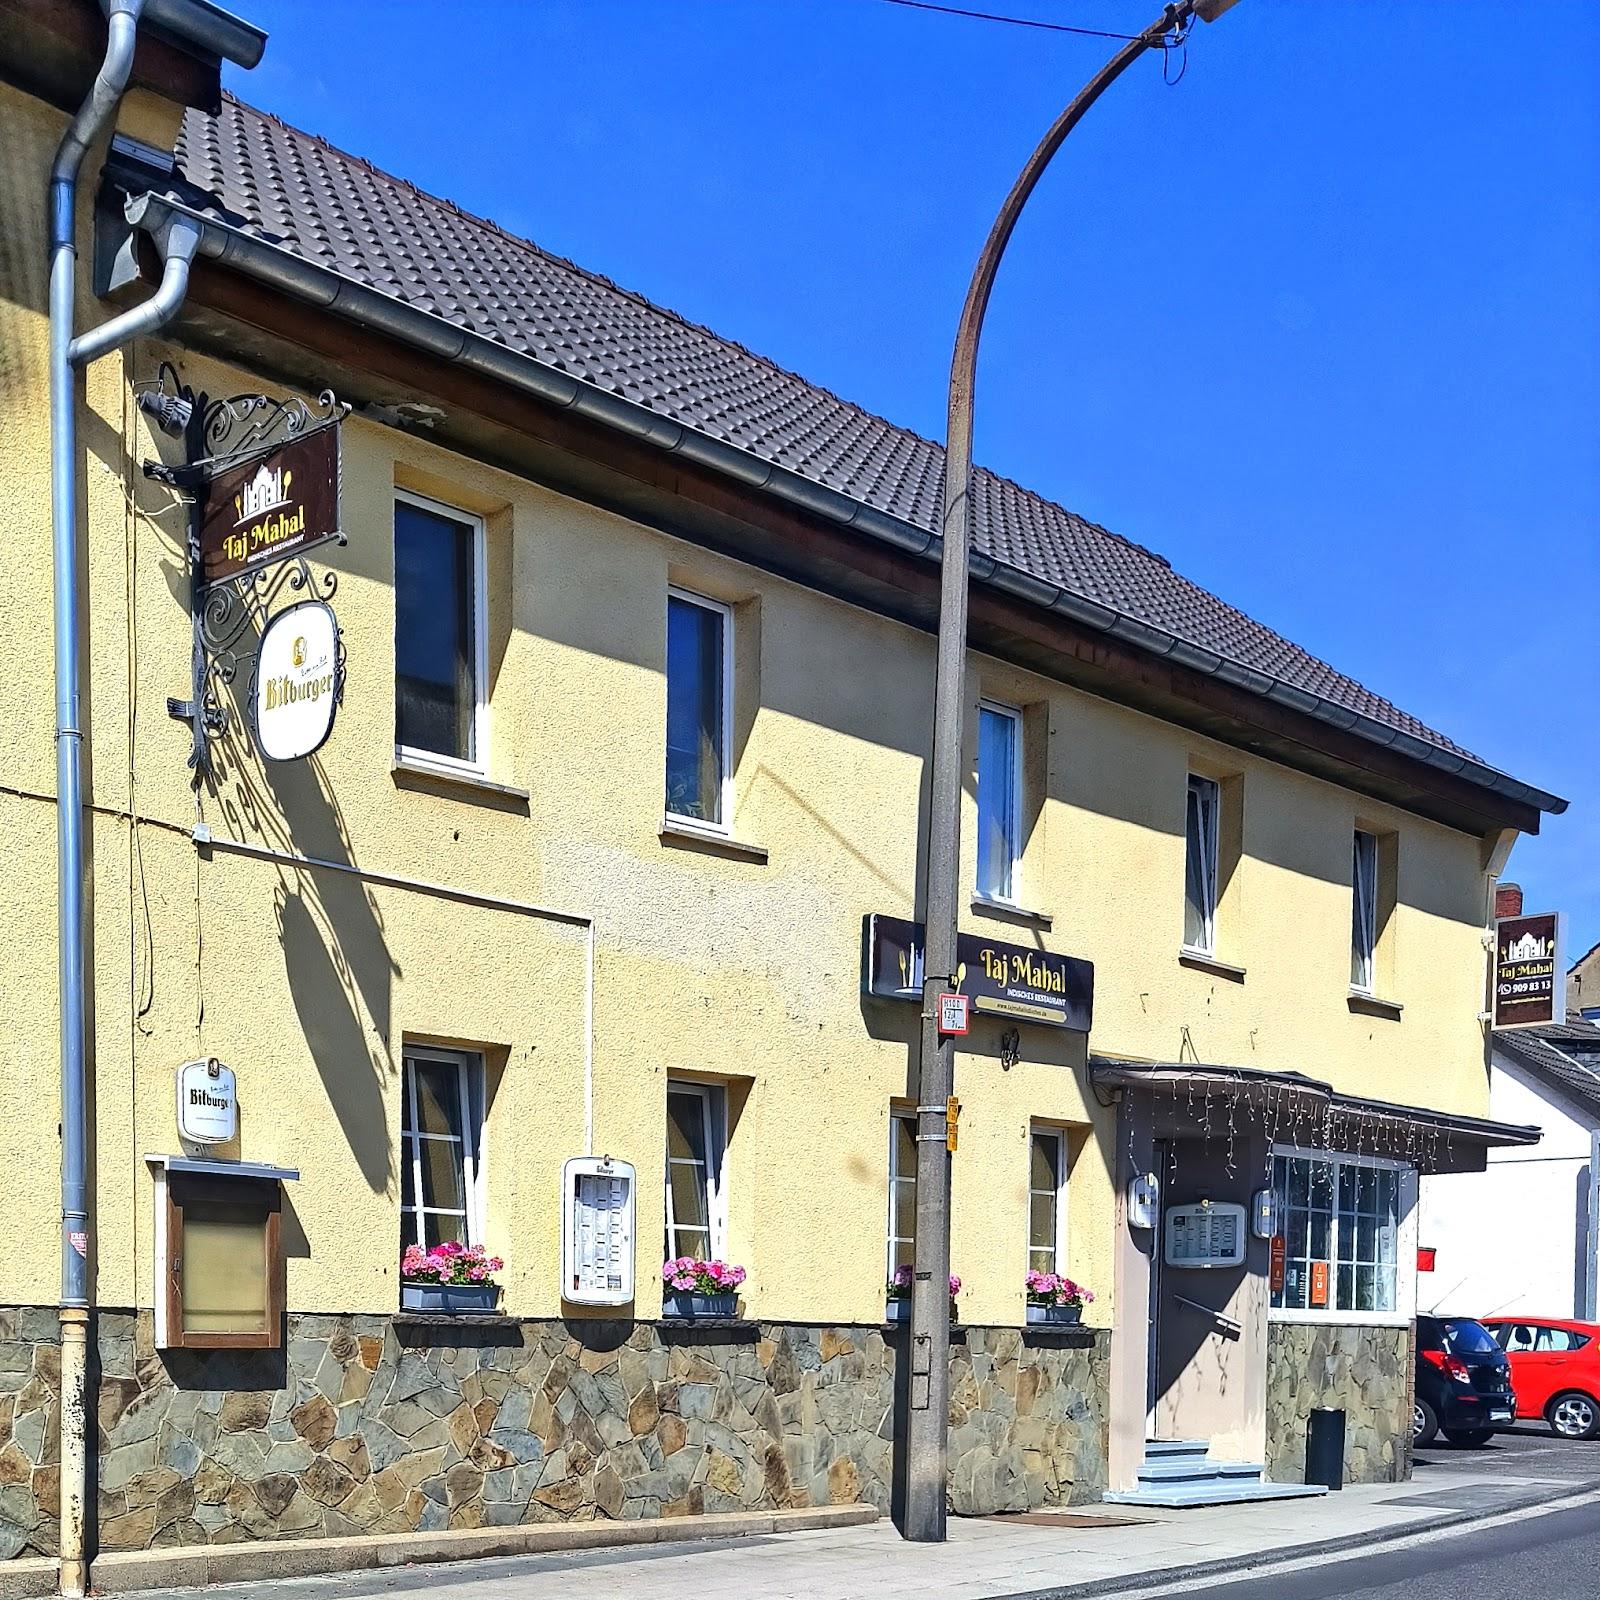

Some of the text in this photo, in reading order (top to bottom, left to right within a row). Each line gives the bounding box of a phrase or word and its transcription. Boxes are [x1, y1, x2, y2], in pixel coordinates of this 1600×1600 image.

[222, 505, 306, 562] Taj Mahal
[265, 674, 333, 711] Bitburger
[980, 949, 1066, 993] Taj Mahal
[1498, 967, 1516, 979] Taj
[1516, 962, 1552, 976] Mahal
[1512, 980, 1551, 993] 909 83 13
